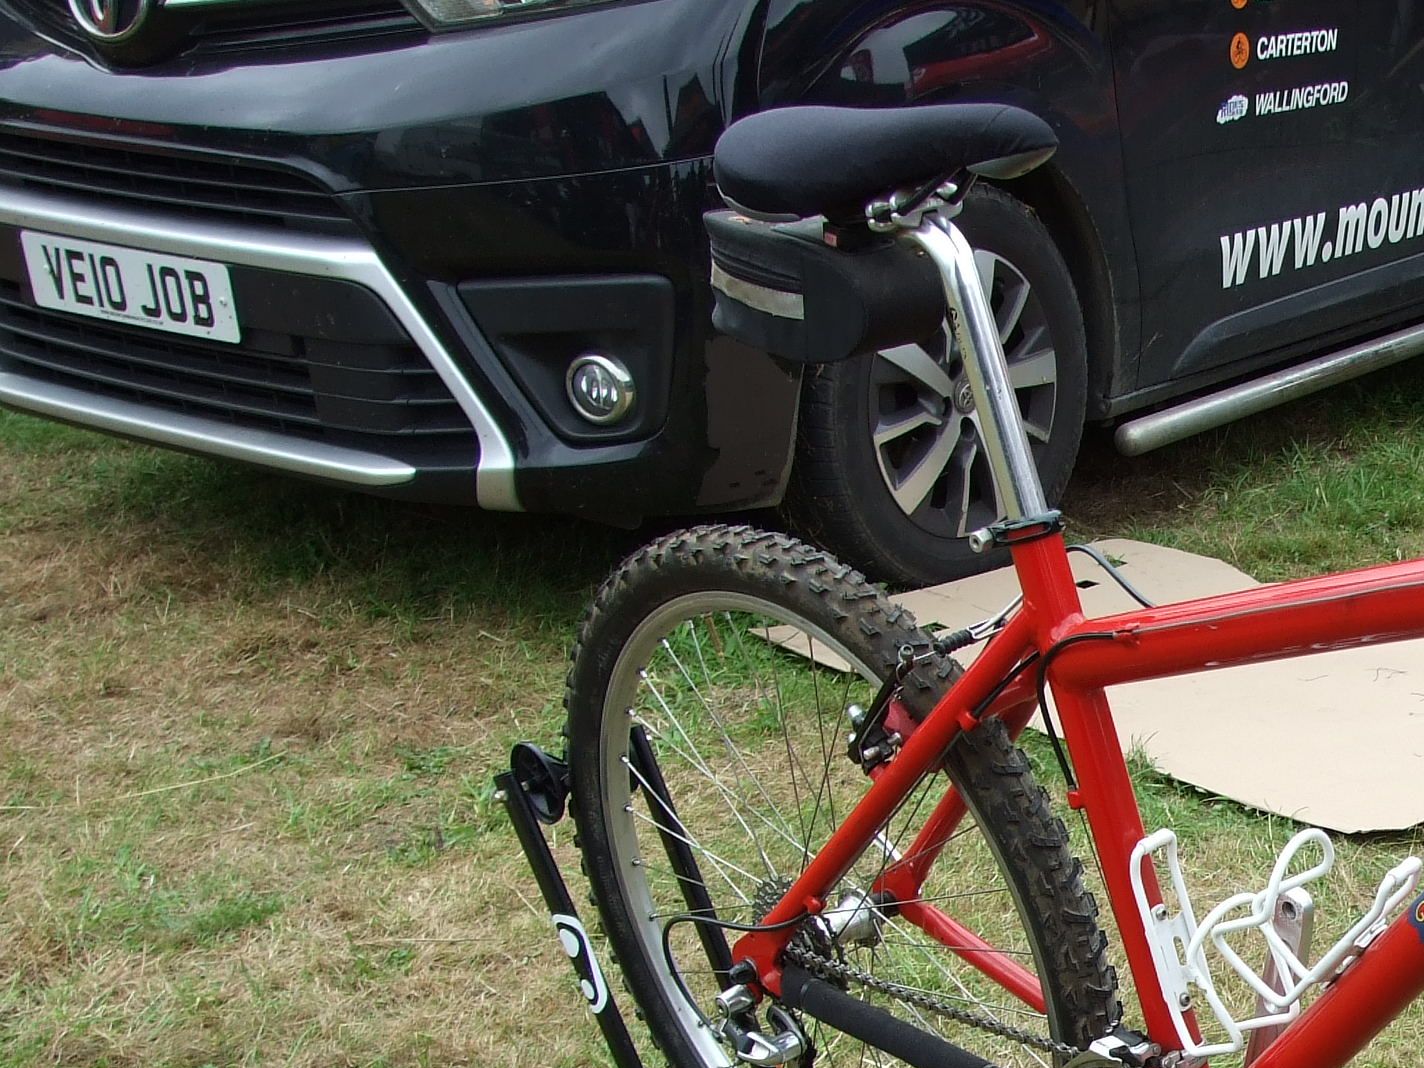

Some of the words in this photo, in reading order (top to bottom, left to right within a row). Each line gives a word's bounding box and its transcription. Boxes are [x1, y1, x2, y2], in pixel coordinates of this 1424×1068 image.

[1256, 28, 1338, 60] CARTERTON
[1255, 81, 1349, 116] WALLINGFORD
[41, 244, 127, 312] VE10
[140, 262, 215, 328] JOB
